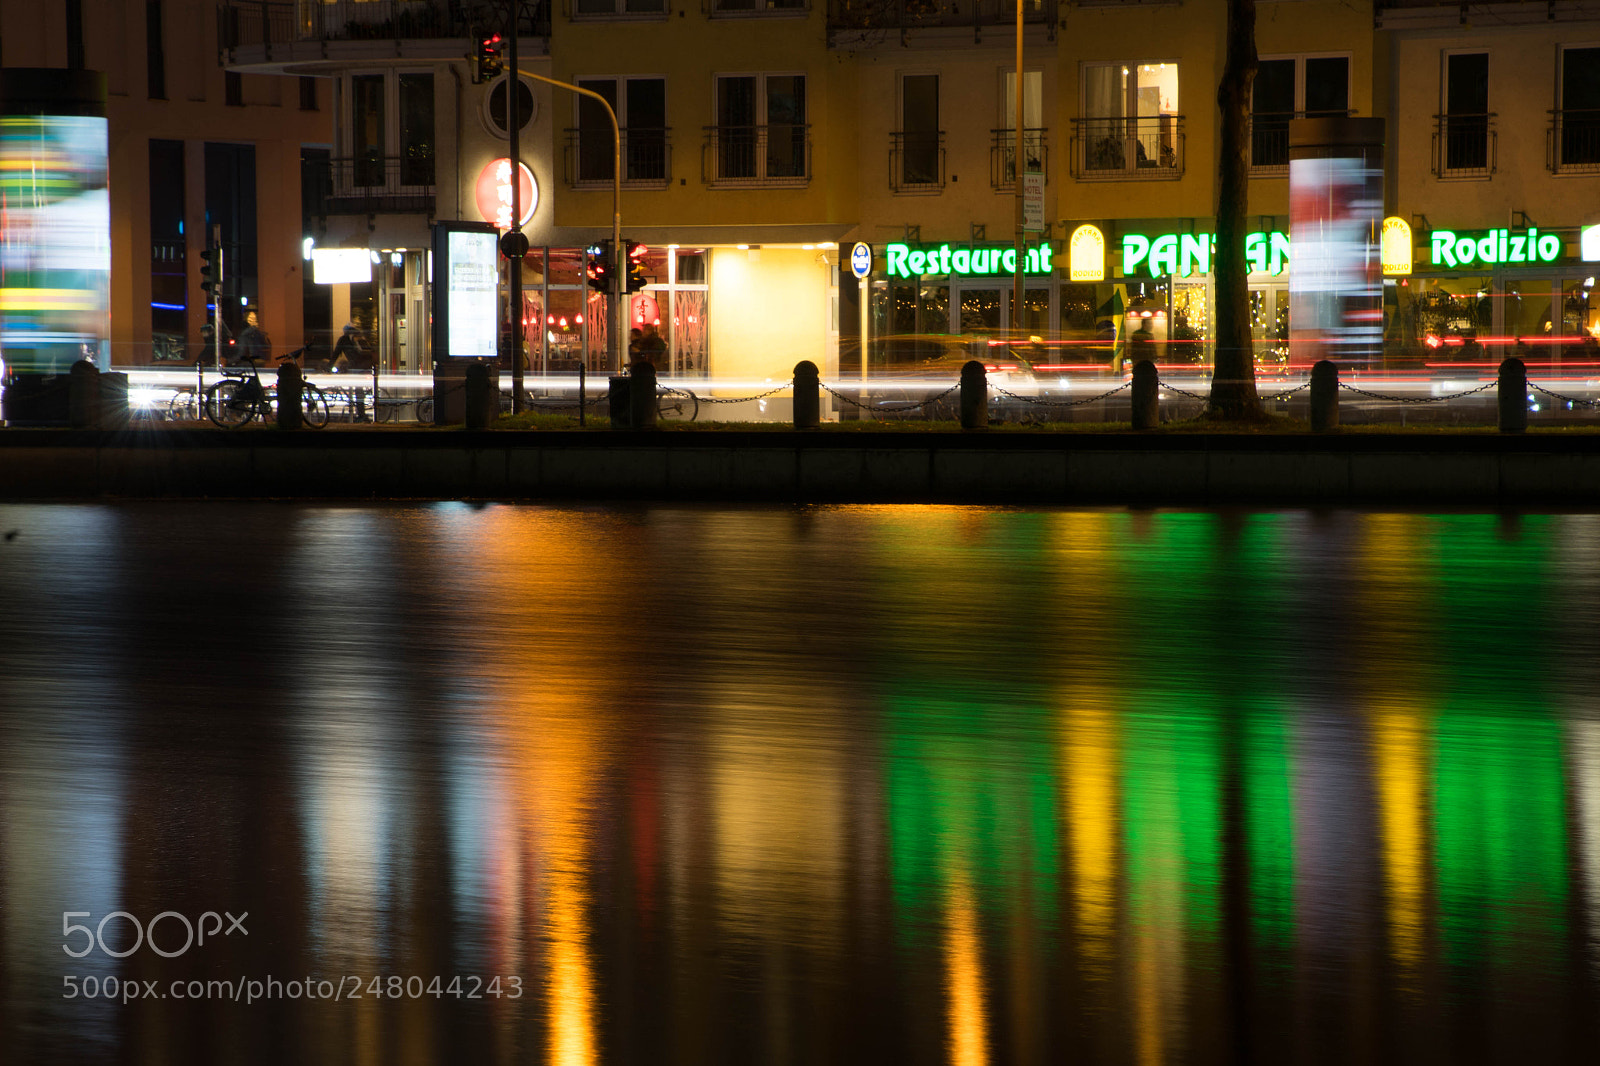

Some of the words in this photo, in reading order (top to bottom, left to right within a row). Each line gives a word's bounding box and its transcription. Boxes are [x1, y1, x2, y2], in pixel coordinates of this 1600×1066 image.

[1024, 185, 1041, 195] HOTEL
[886, 242, 1053, 279] Restaurant
[1121, 231, 1290, 279] PANAN
[1431, 227, 1561, 268] Rodizio
[1072, 269, 1103, 278] RODIZIO
